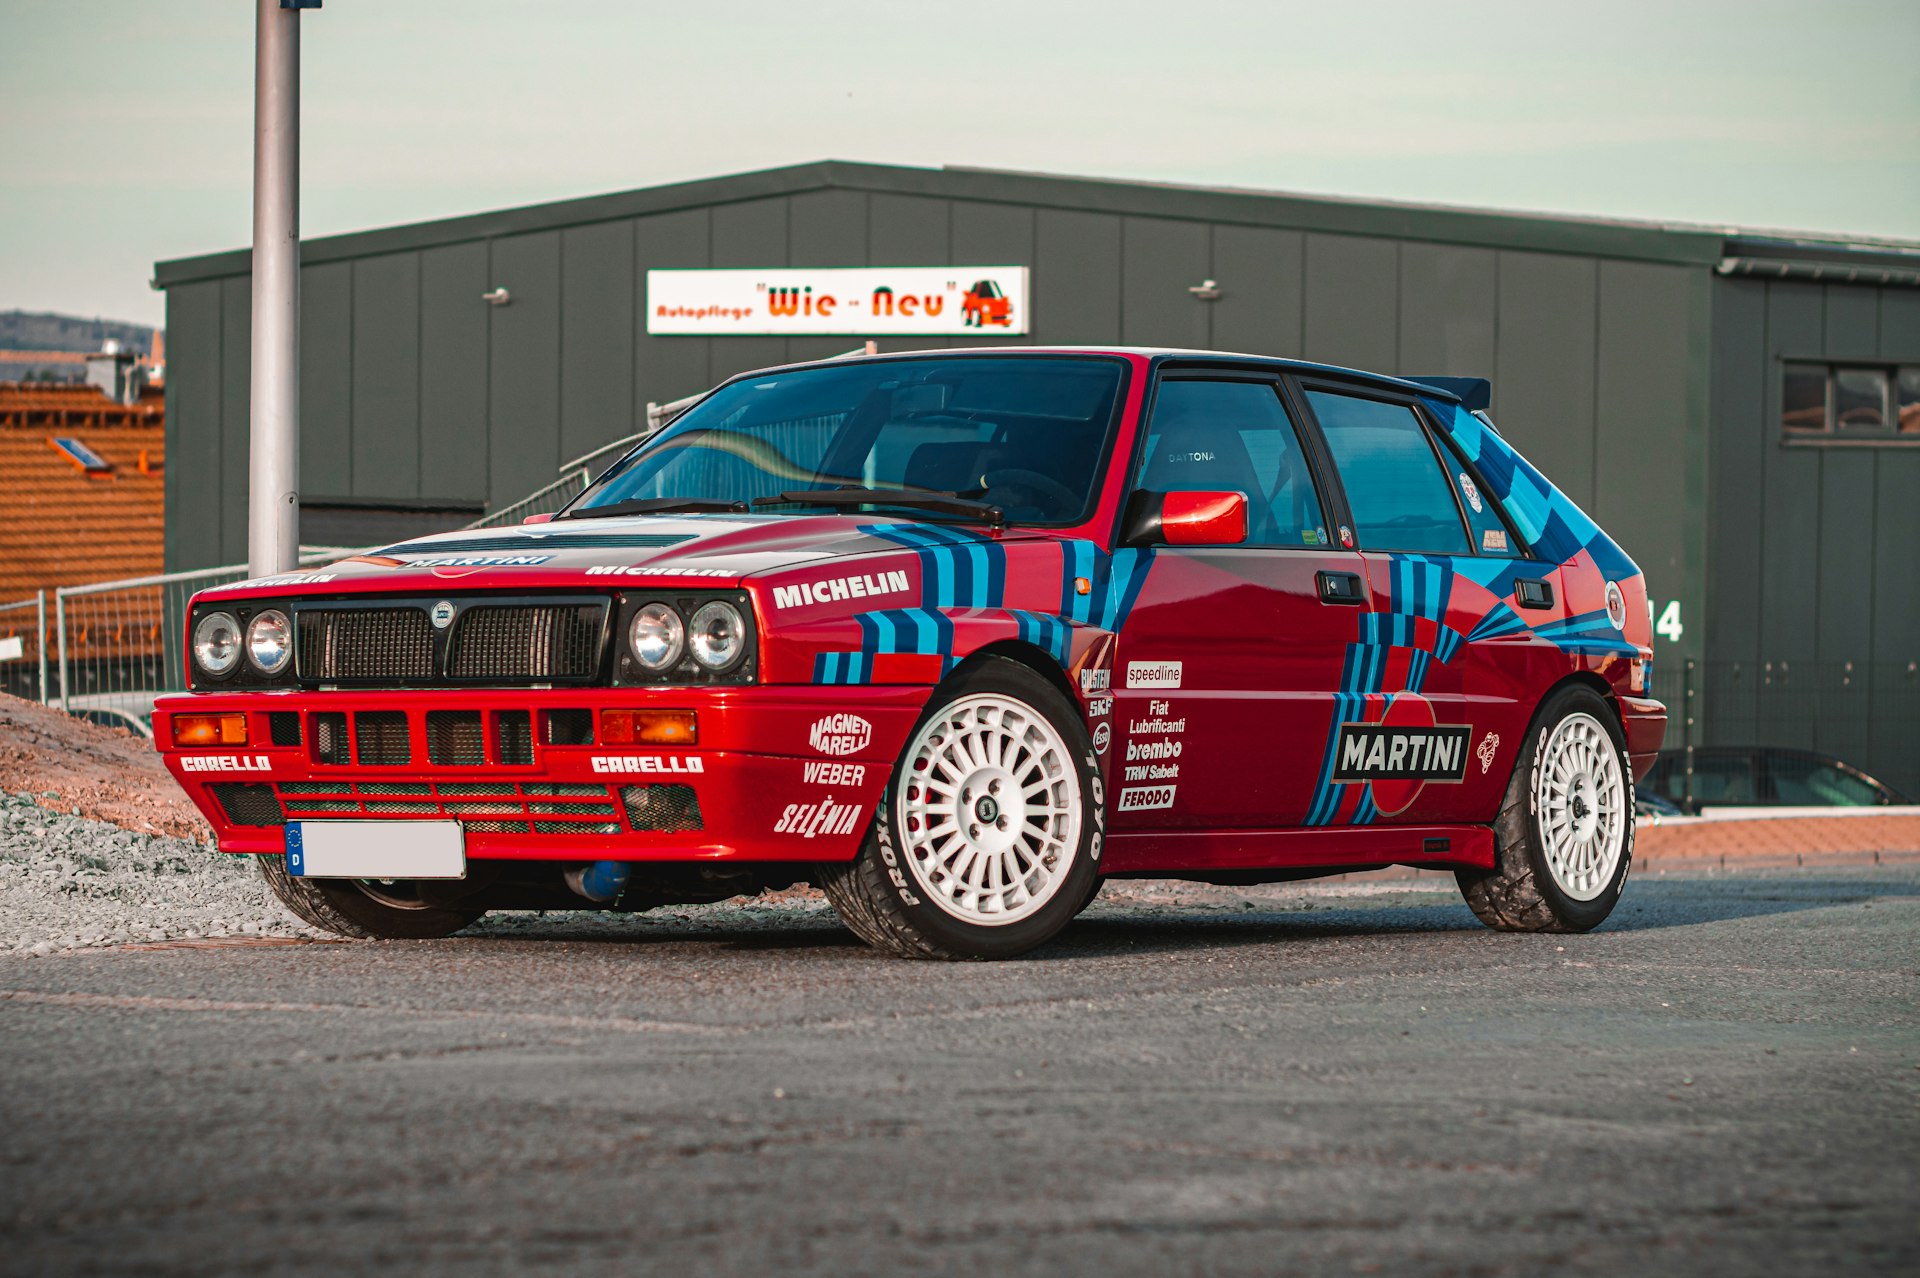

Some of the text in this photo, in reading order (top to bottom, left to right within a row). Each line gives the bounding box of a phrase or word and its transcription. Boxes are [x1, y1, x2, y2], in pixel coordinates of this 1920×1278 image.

[657, 305, 752, 320] Autopflege
[1168, 452, 1216, 463] DAYTONA
[406, 556, 549, 567] MARTINI
[585, 566, 738, 577] MICHELIN
[773, 570, 910, 609] MICHELIN
[1129, 665, 1180, 684] speedline
[1089, 697, 1113, 717] SKF
[1150, 700, 1169, 715] Fiat
[1130, 718, 1185, 734] Lubrificanti
[1096, 731, 1108, 745] Esso
[1126, 737, 1182, 761] brembo
[1341, 734, 1463, 771] MARTINI
[180, 756, 272, 772] CARELLO
[591, 756, 704, 773] CARELLO
[1125, 763, 1179, 781] TRW Sabelt
[1530, 726, 1548, 816] TOYO
[803, 762, 865, 786] WEBER
[1085, 749, 1104, 861] TOYO
[1123, 789, 1170, 807] FERODO
[1623, 750, 1636, 856] PROXES
[292, 854, 300, 866] D
